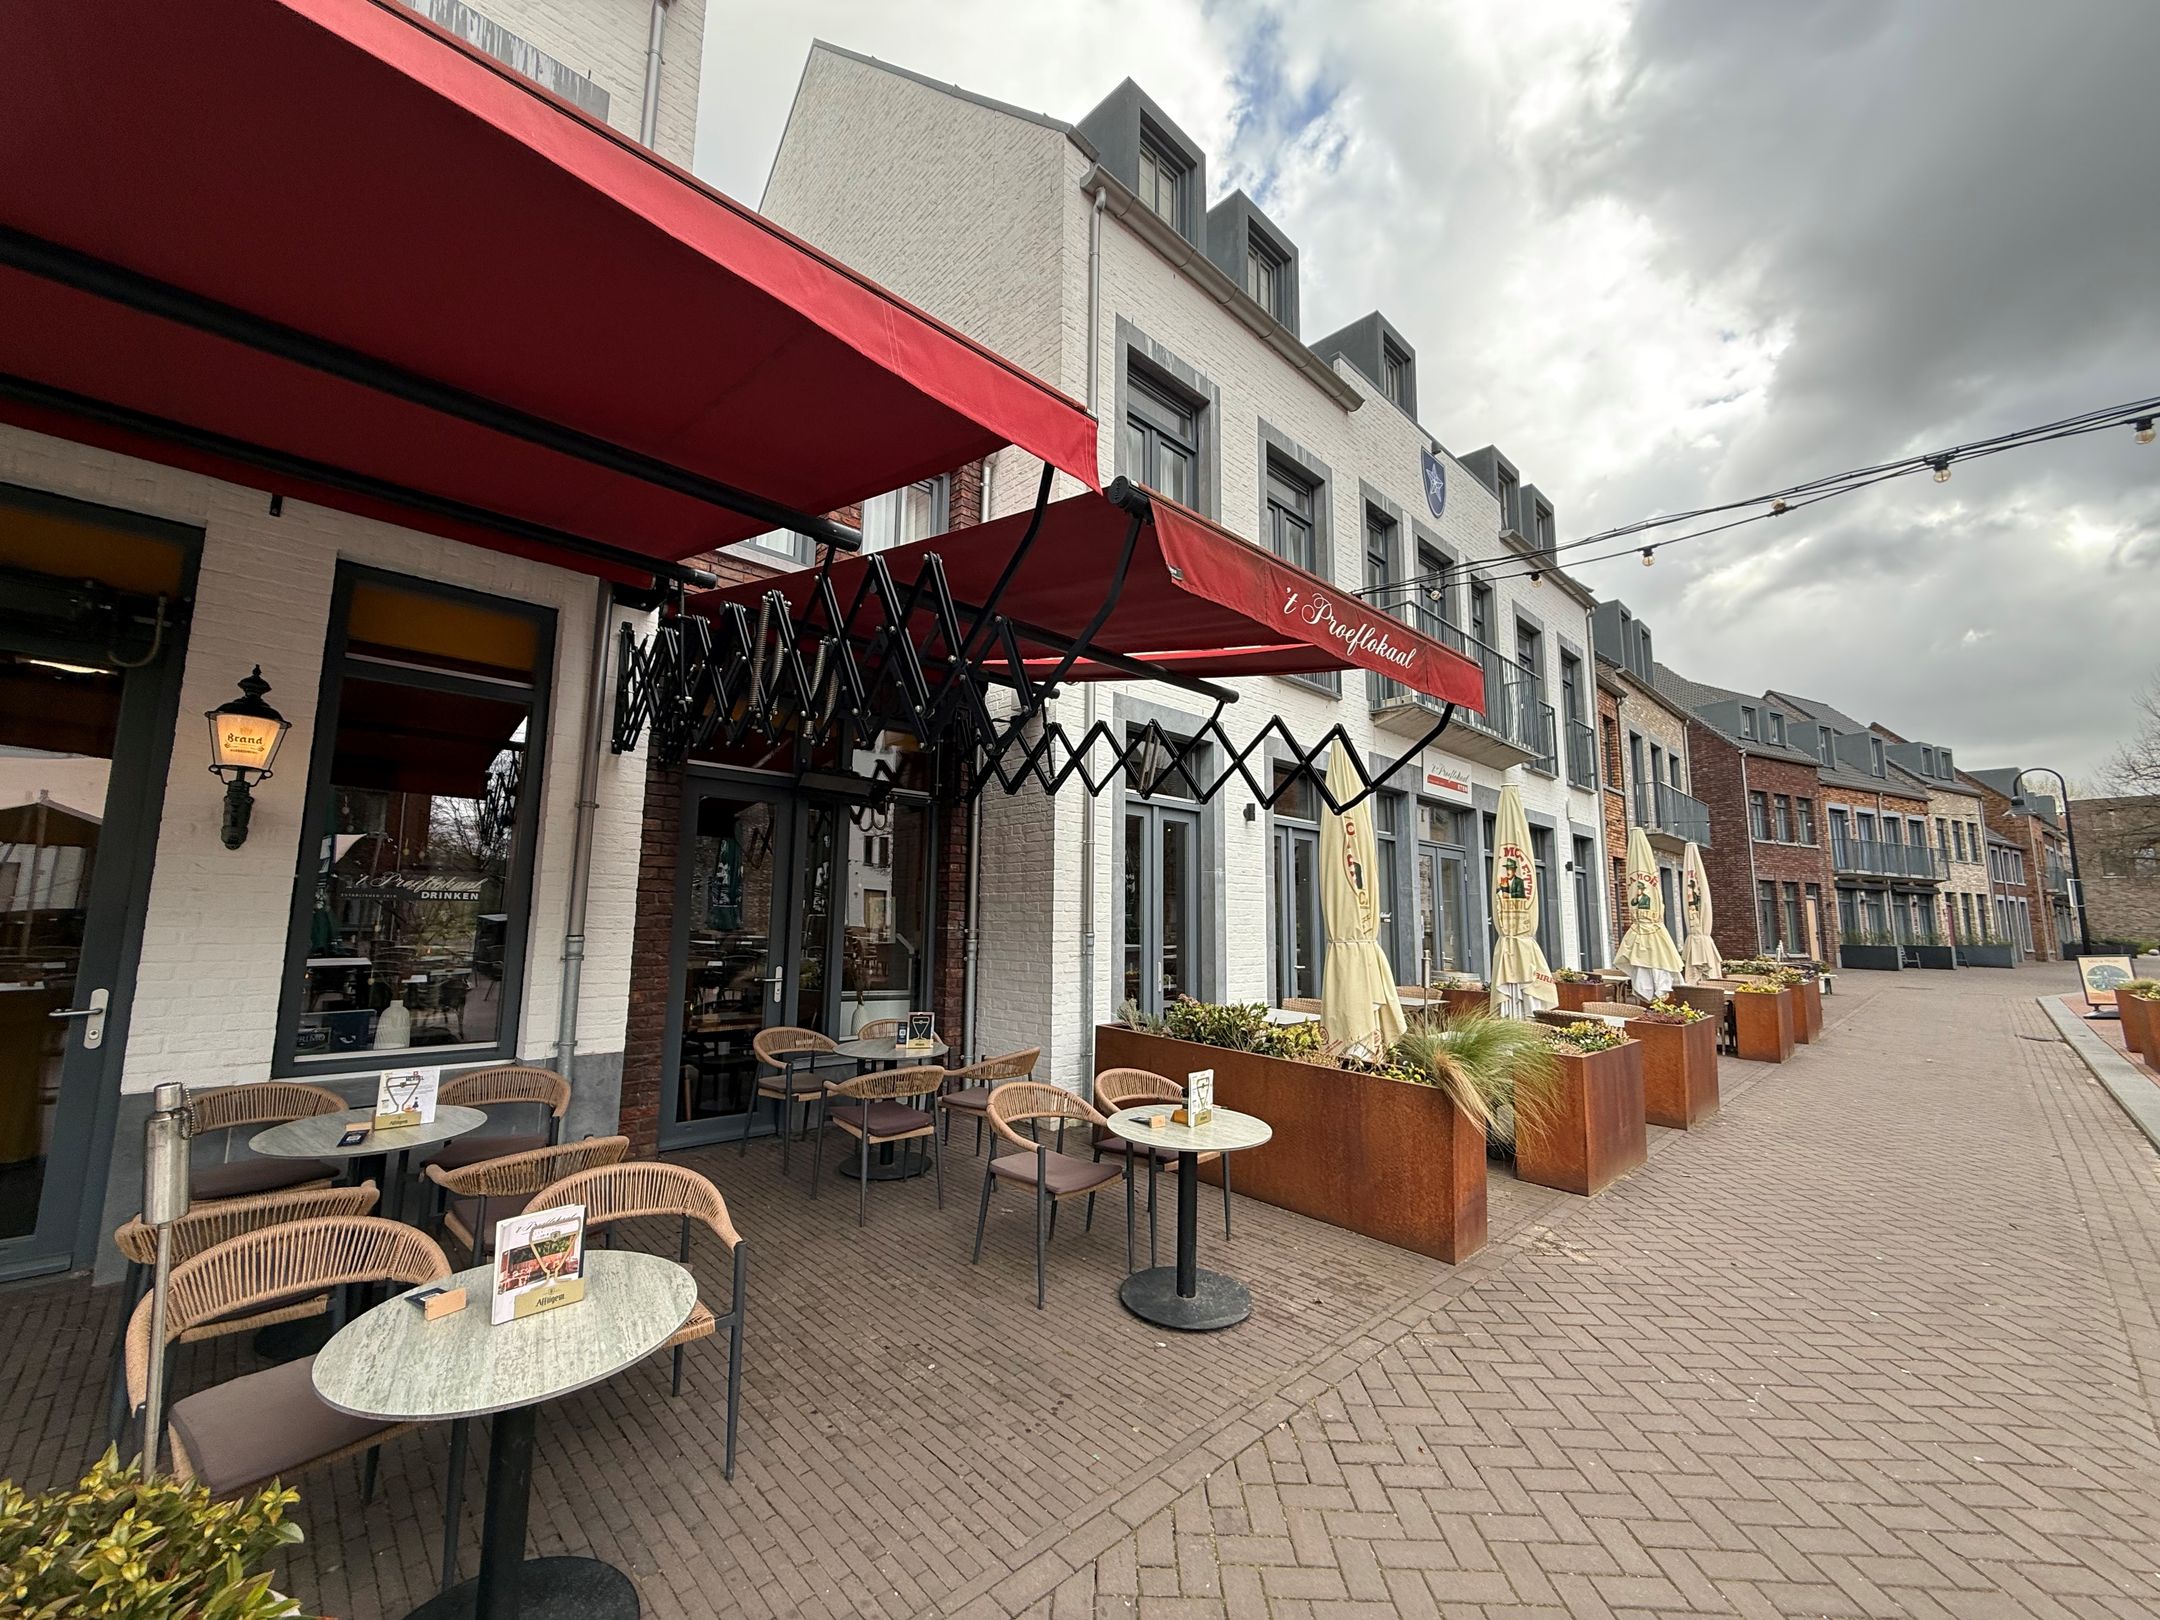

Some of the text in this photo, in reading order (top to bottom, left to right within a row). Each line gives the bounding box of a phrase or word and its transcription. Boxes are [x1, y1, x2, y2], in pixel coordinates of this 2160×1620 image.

[1284, 587, 1417, 669] 't Proeflokaal
[227, 733, 263, 745] Brand
[1503, 847, 1533, 900] MOETT
[421, 891, 479, 900] DRINKEN
